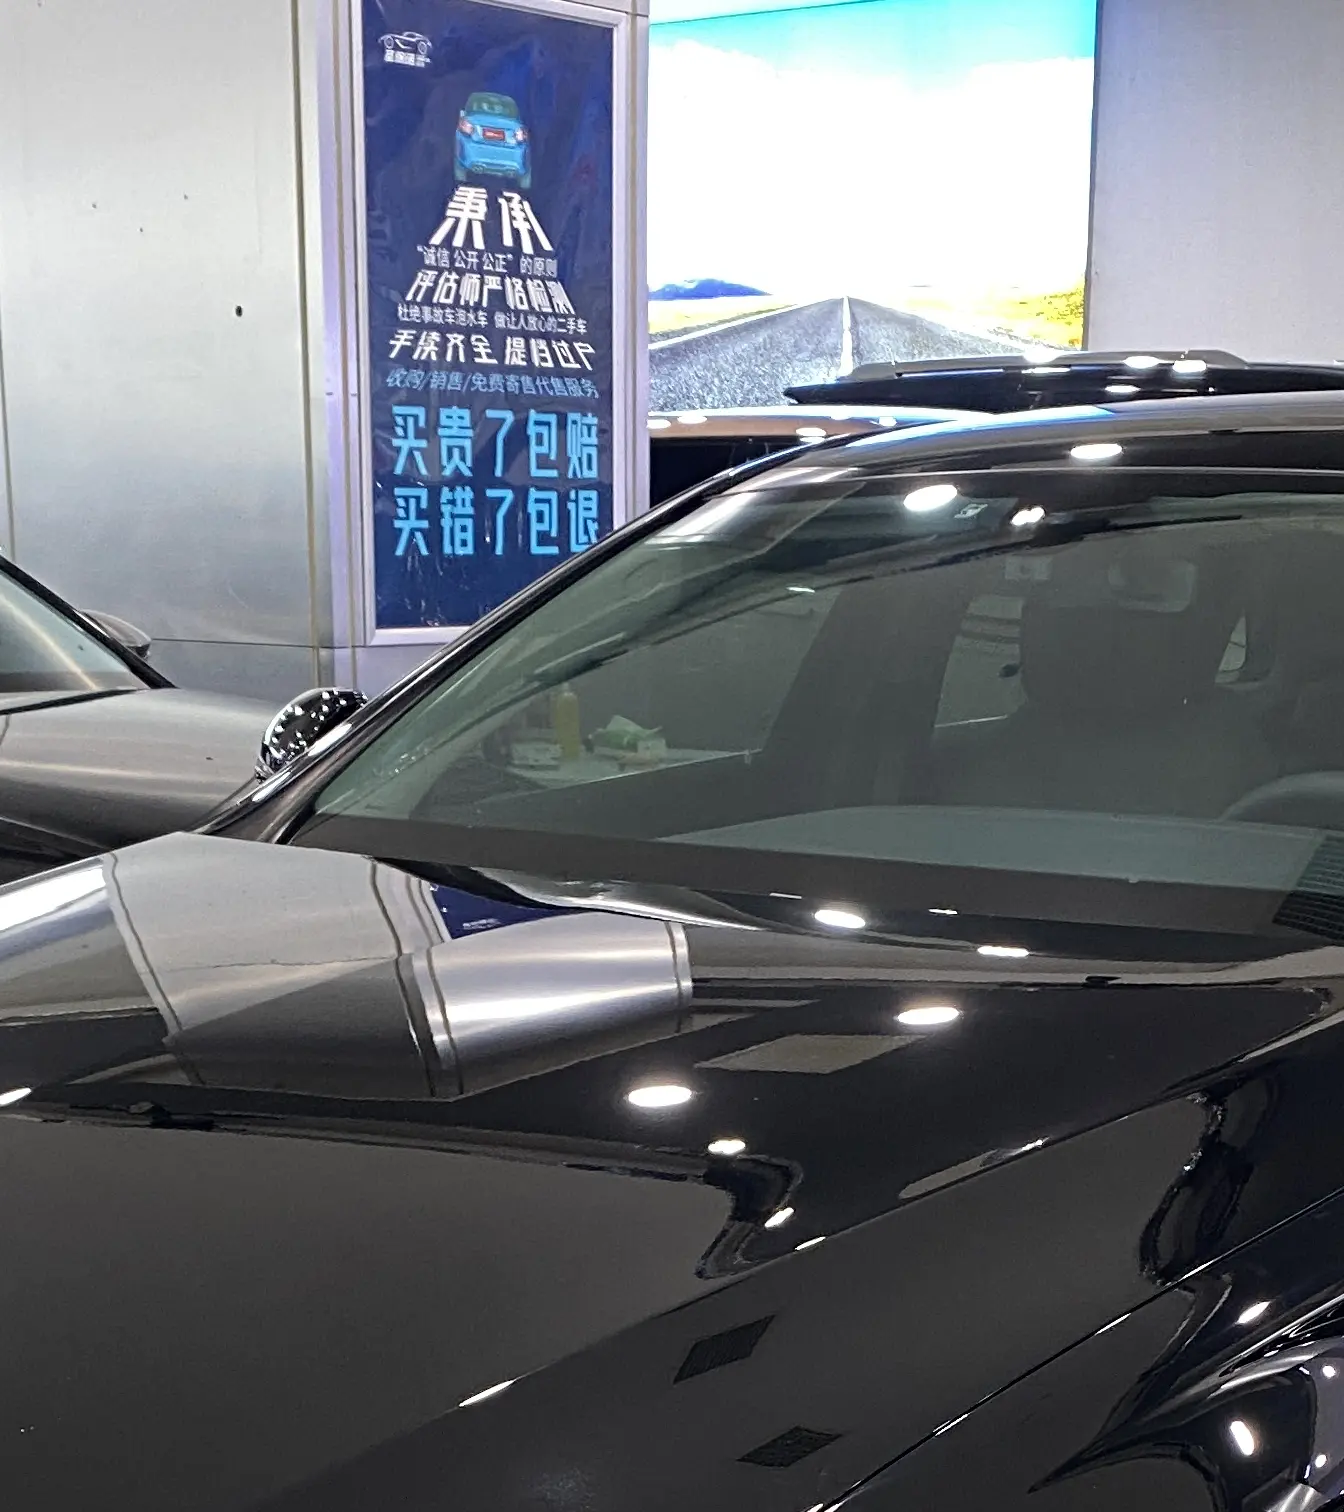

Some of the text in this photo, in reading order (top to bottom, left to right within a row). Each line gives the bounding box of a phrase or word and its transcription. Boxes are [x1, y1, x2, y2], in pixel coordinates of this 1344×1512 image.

[429, 186, 553, 254] 秉承
[406, 270, 576, 314] 评估师严格检测
[388, 328, 597, 371] 手续齐全 提档过户
[392, 405, 598, 478] 买贵了包赔
[392, 485, 599, 555] 买错了包退
